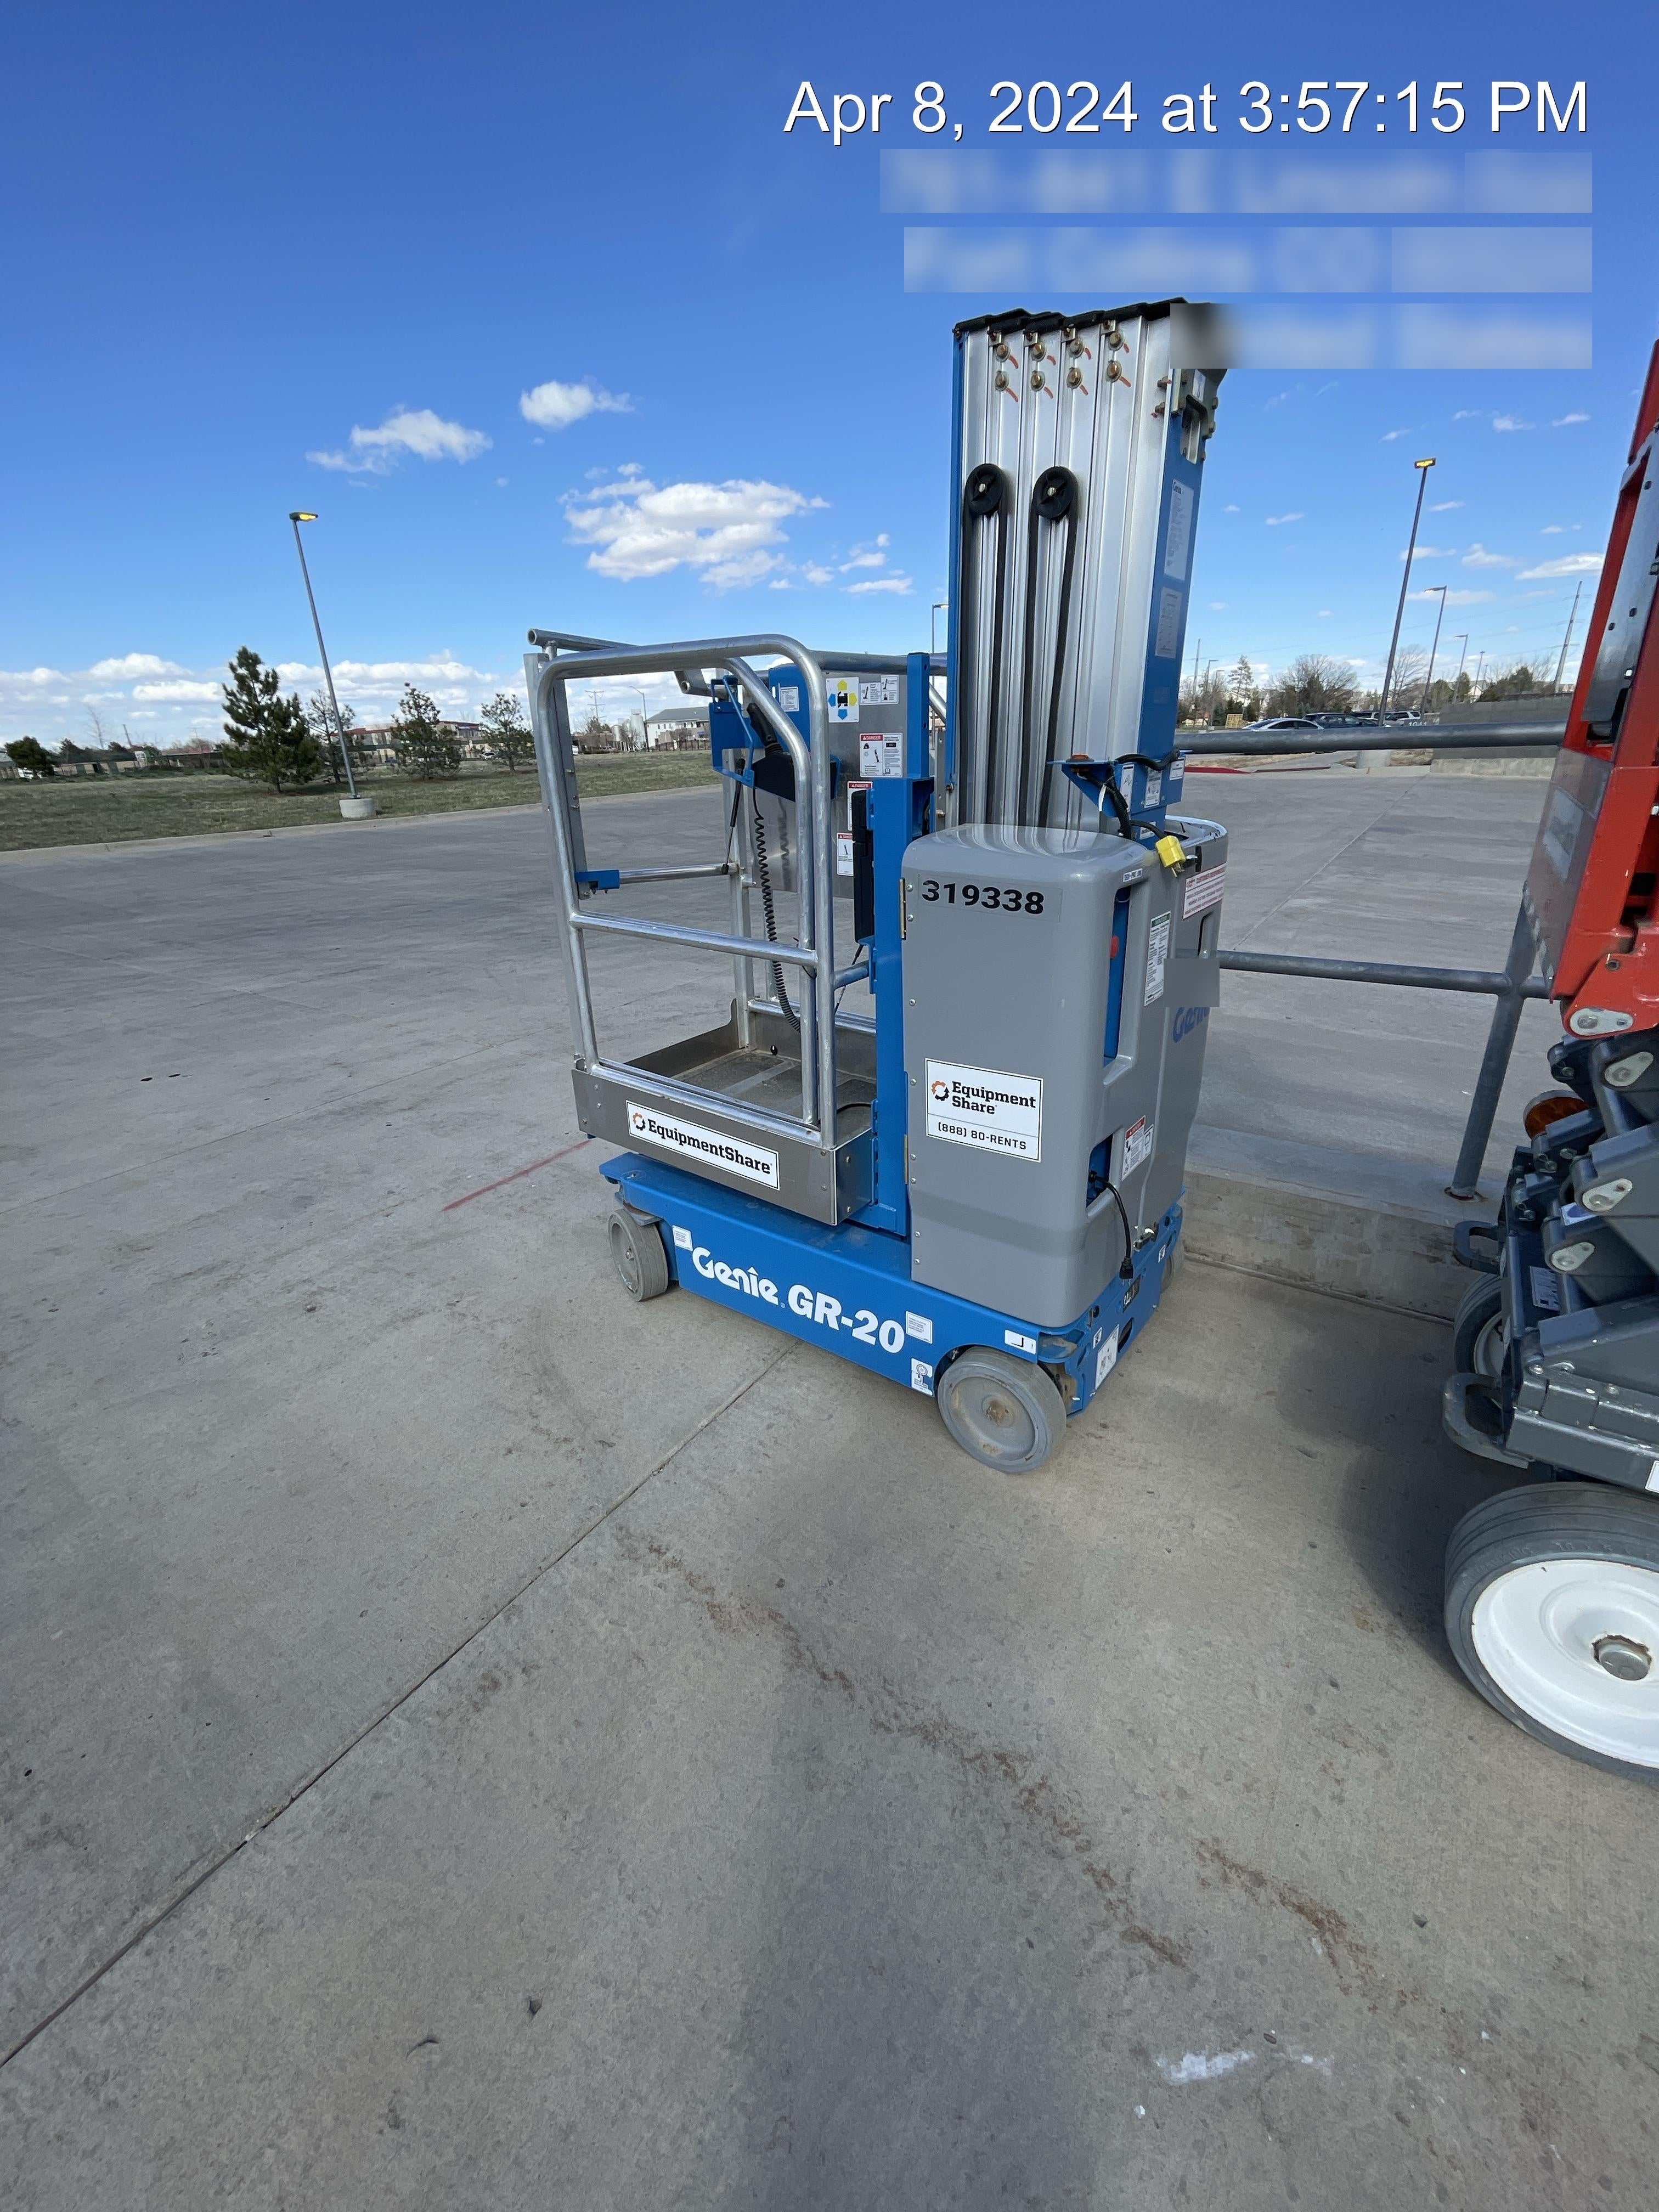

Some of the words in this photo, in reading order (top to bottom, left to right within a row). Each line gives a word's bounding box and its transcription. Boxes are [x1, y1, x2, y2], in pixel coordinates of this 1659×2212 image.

[922, 880, 1044, 915] 319338
[952, 1081, 1036, 1108] Equipment
[952, 1096, 995, 1114] Share
[647, 1119, 771, 1174] EquipmentShare
[938, 1122, 967, 1137] (888)
[971, 1130, 1026, 1150] 80-RENTS
[692, 1246, 778, 1305] Genie
[788, 1284, 905, 1353] GR-20
